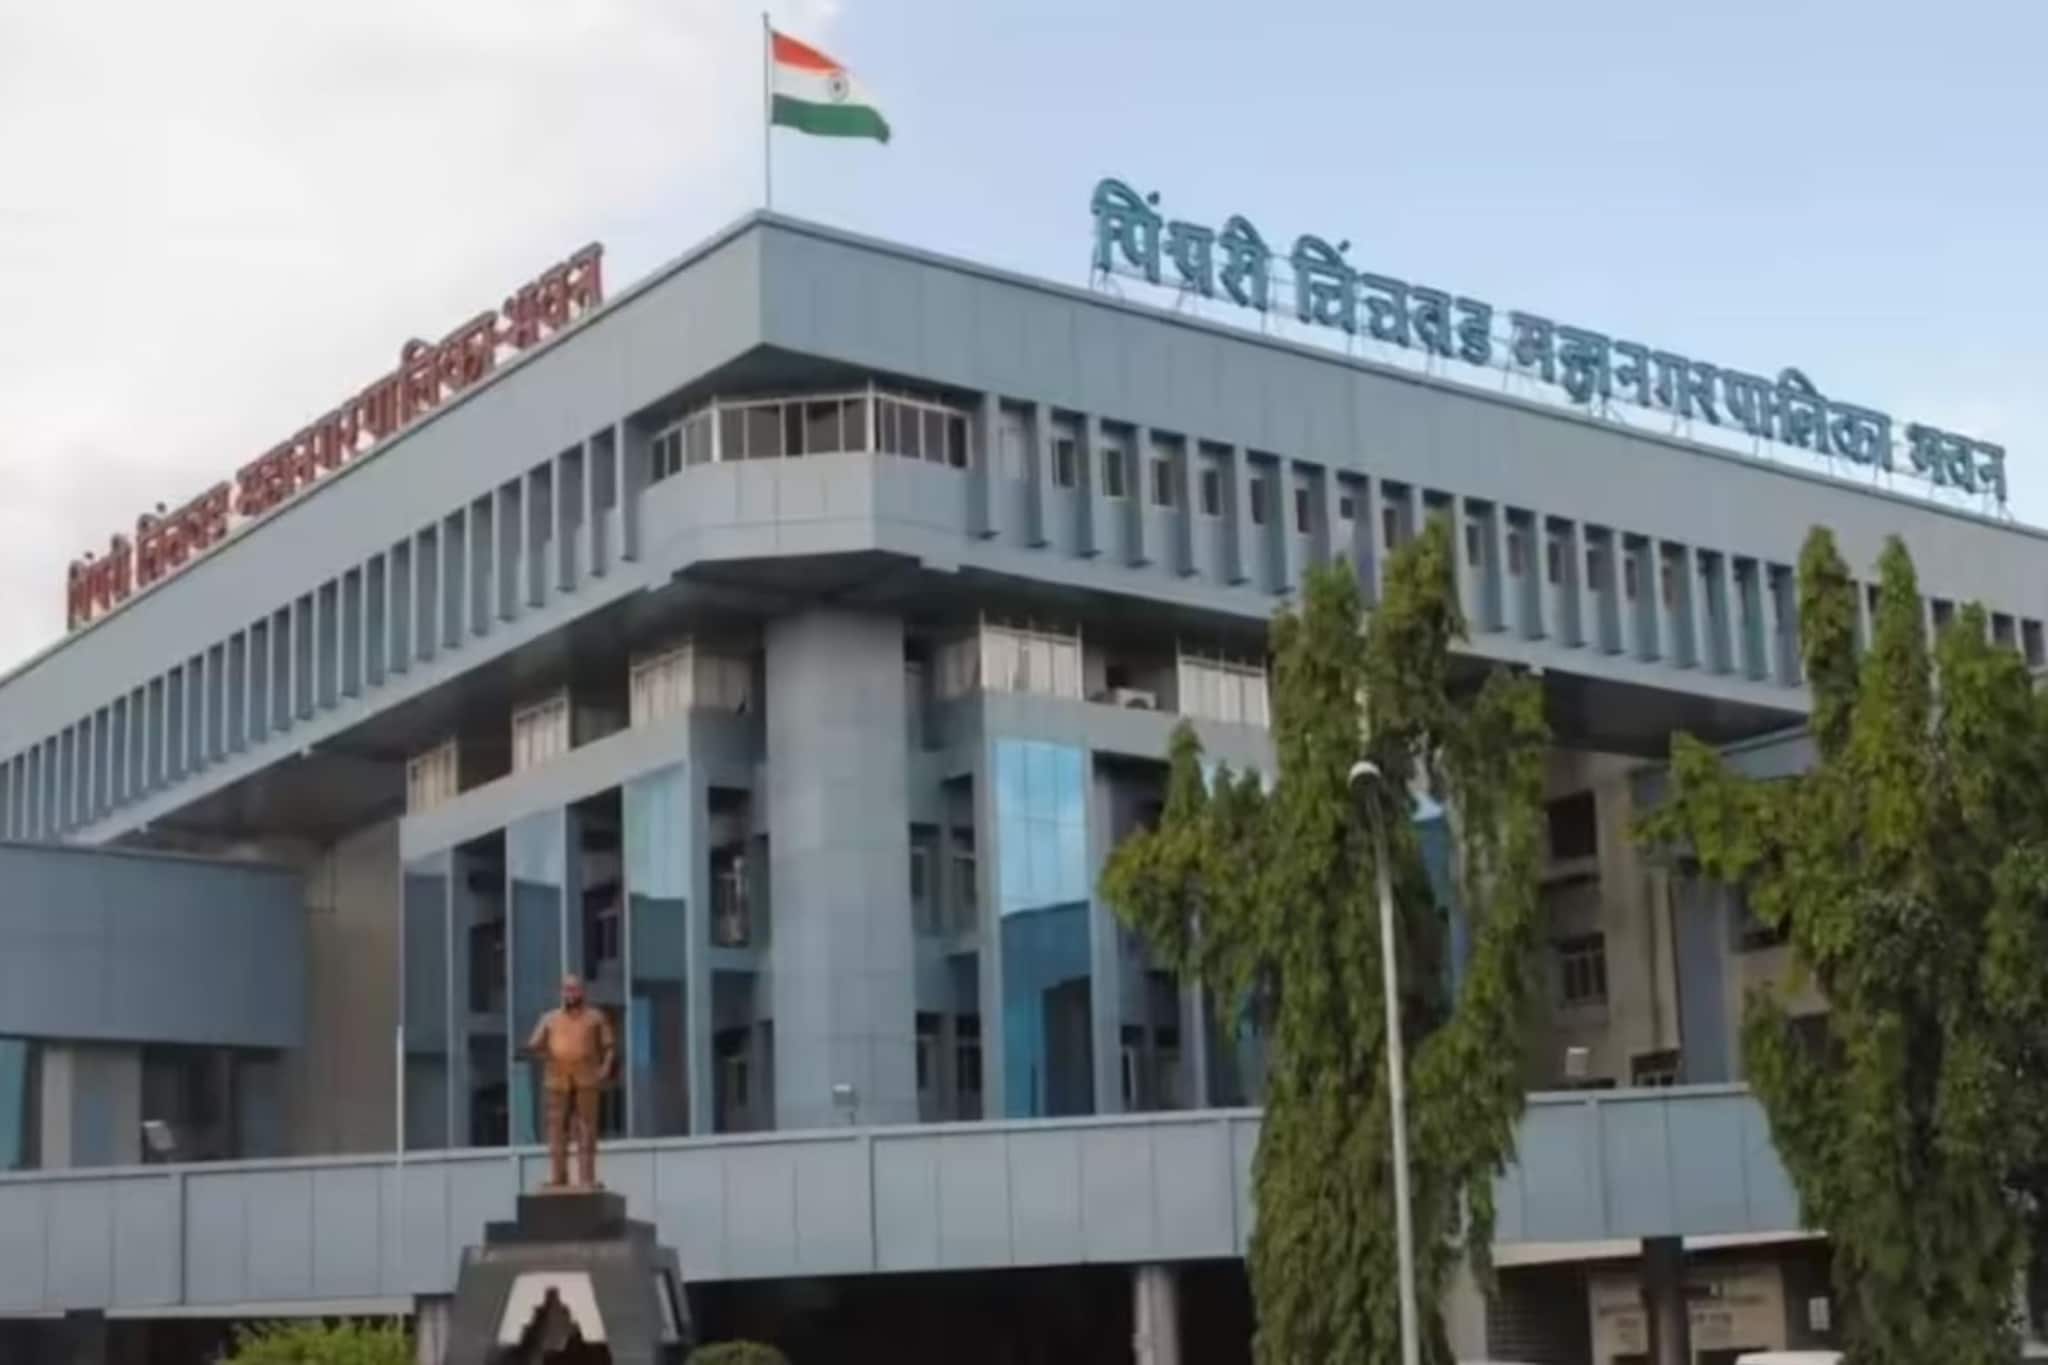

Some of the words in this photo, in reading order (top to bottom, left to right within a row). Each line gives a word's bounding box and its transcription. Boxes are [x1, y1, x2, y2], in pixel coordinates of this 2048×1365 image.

[1092, 177, 1268, 312] पिंपरी
[1292, 234, 1492, 366] चिंचवड
[1508, 310, 1894, 472] महानगरपालिका
[1907, 422, 2007, 505] भवन
